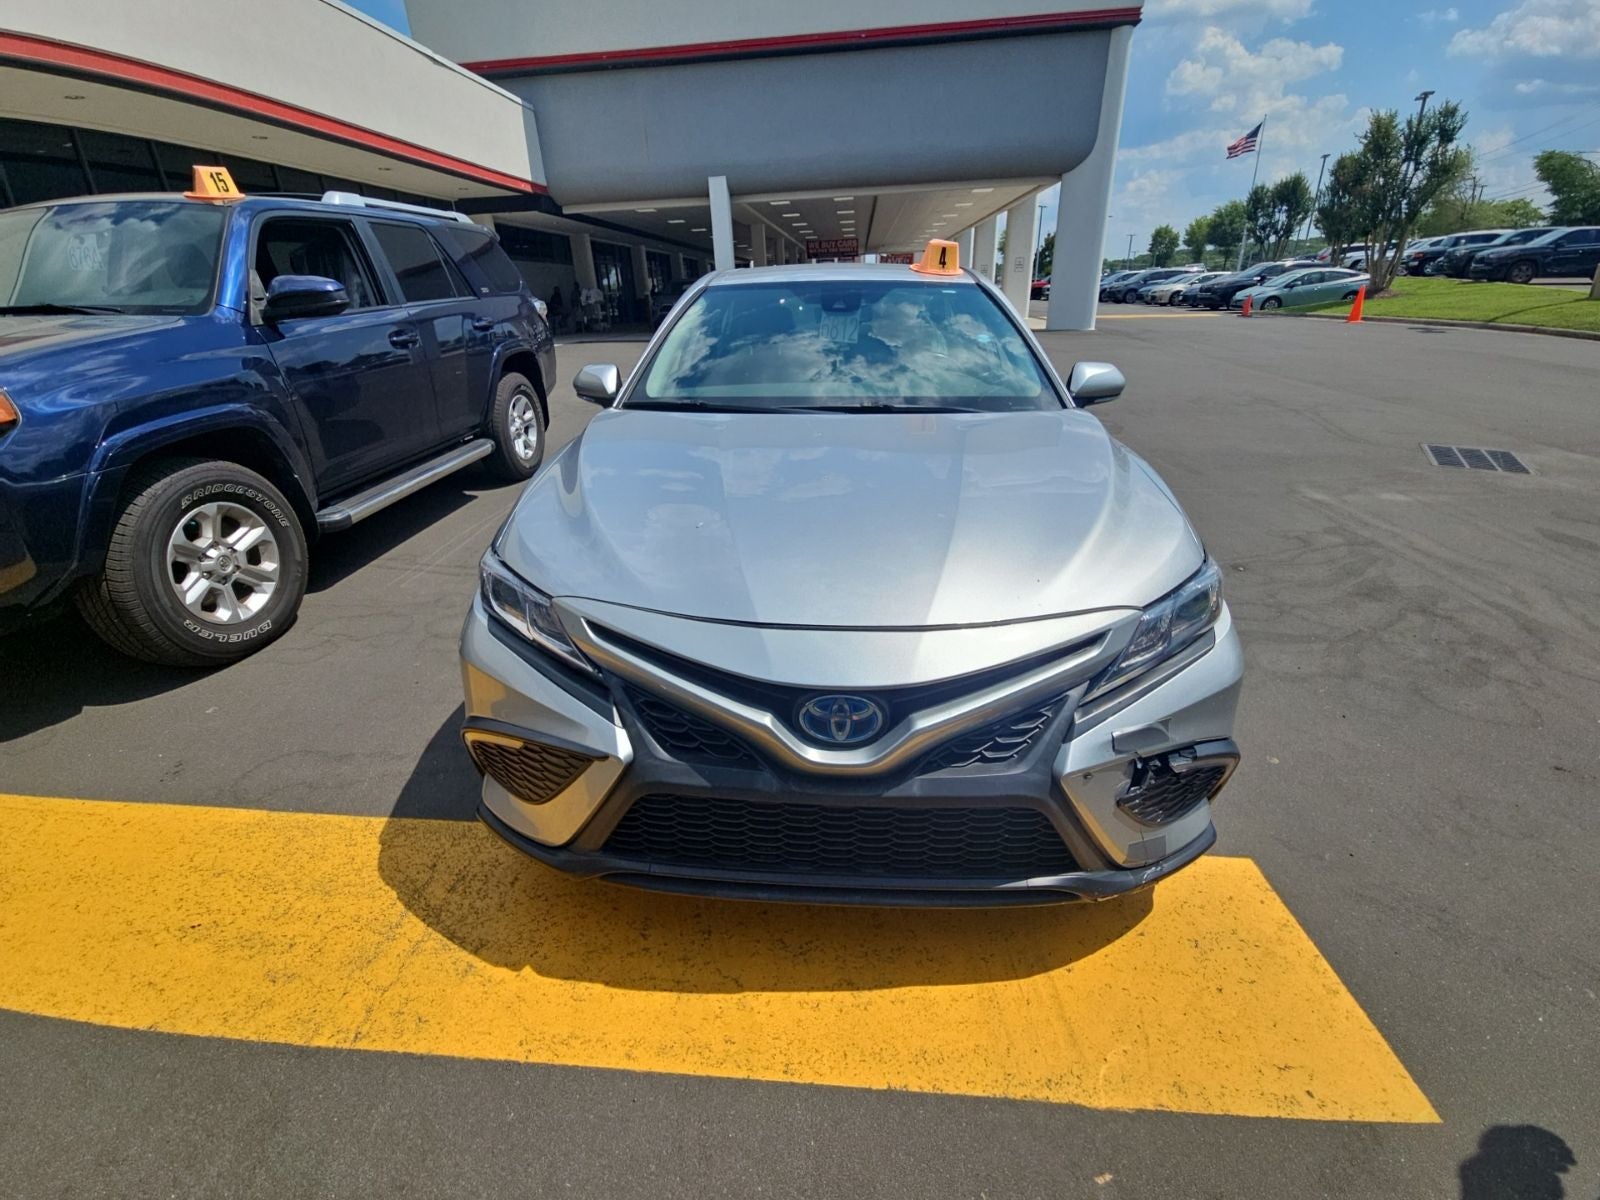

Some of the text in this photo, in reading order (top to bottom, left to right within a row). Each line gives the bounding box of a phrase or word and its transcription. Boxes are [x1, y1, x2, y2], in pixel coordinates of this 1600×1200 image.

[210, 172, 230, 192] 15
[808, 239, 857, 249] WE BUY CARS
[939, 246, 947, 269] 4
[821, 316, 858, 342] 6812
[181, 483, 290, 527] BRIDGESTONE
[183, 620, 272, 643] DUELER
